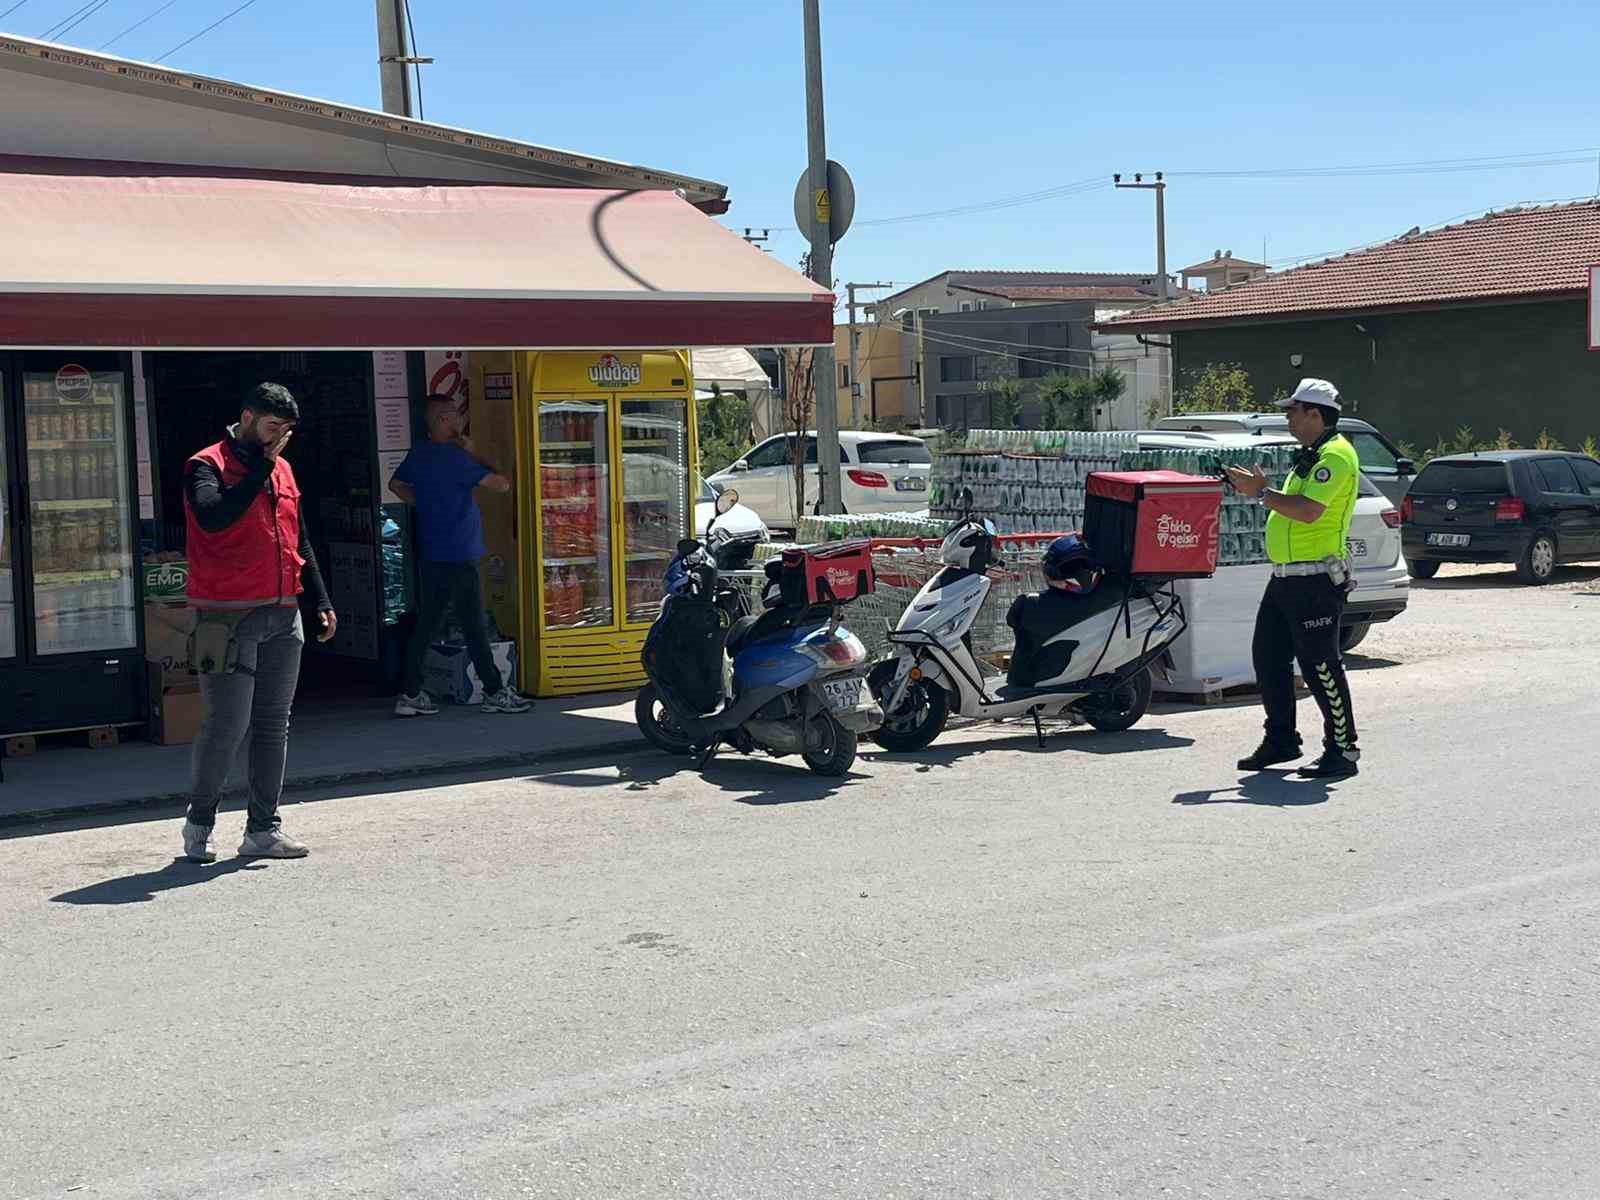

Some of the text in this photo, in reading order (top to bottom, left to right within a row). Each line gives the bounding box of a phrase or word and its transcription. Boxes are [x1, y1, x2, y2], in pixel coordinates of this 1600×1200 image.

[51, 52, 105, 71] INTERPANEL
[128, 68, 181, 86] INTERPANEL
[203, 83, 255, 101] INTERPANEL
[589, 363, 641, 384] uludağ
[1169, 533, 1199, 548] gelsin
[146, 572, 184, 587] EMA
